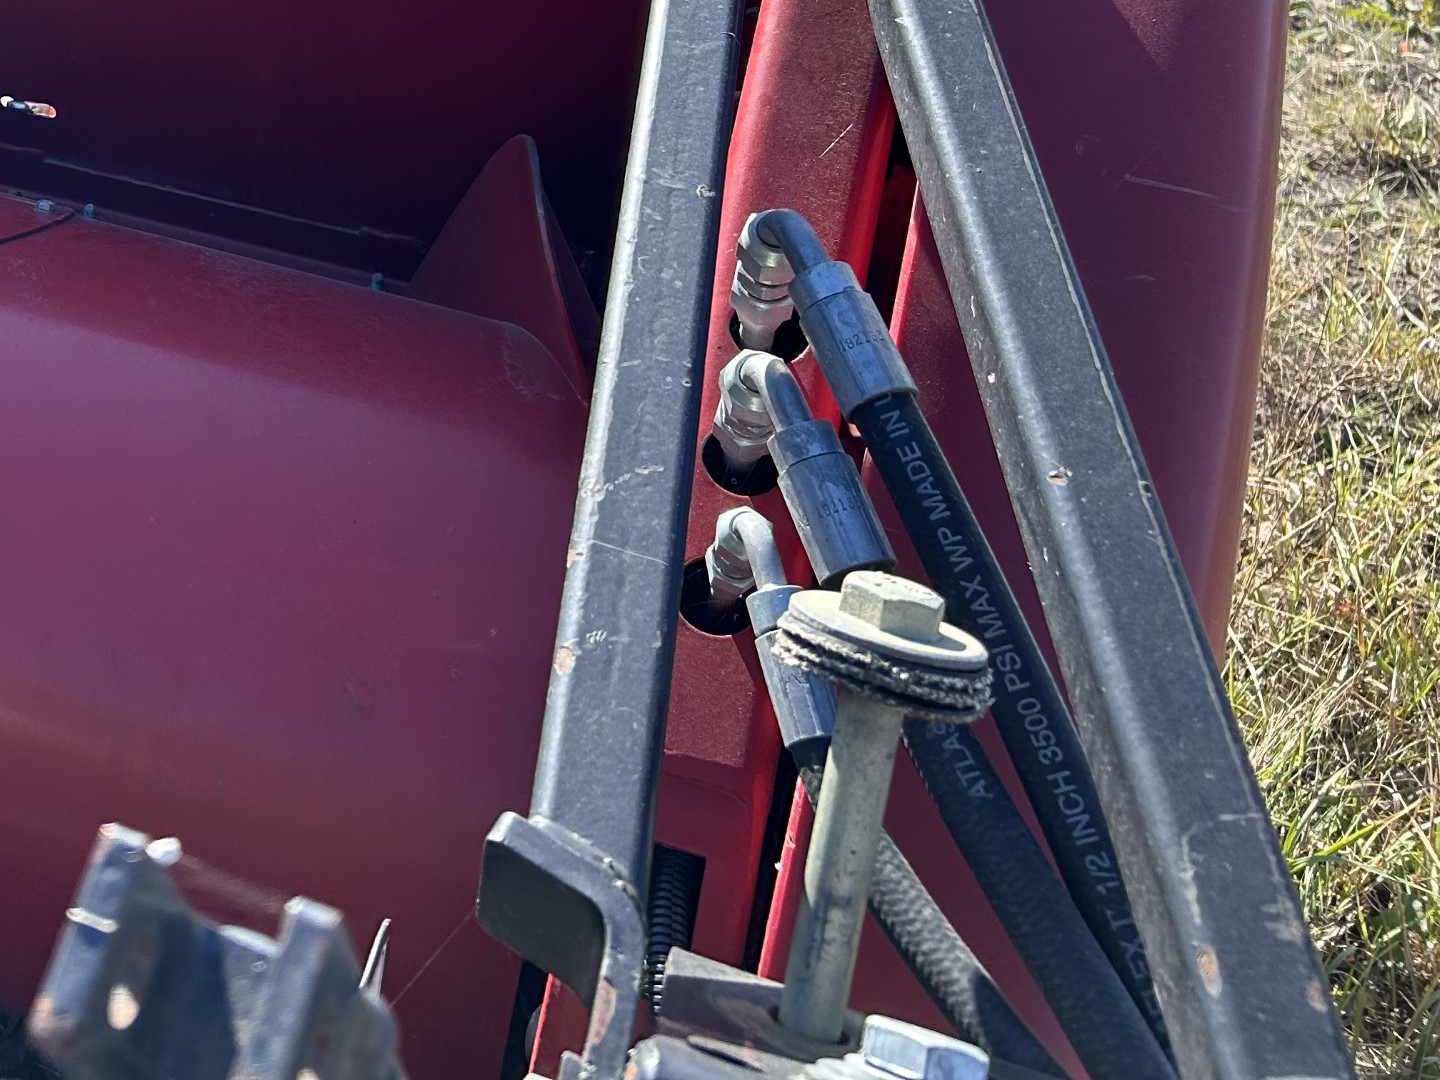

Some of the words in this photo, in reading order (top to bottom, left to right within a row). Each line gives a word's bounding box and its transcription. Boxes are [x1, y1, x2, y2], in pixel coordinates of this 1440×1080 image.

[880, 409, 910, 439] IN
[896, 441, 951, 521] MADE
[937, 526, 974, 573] WP
[959, 574, 1007, 639] MAX
[990, 643, 1032, 693] PSI
[1016, 696, 1064, 765] 3500
[1045, 769, 1100, 846] INCH
[1084, 850, 1121, 895] 1/2
